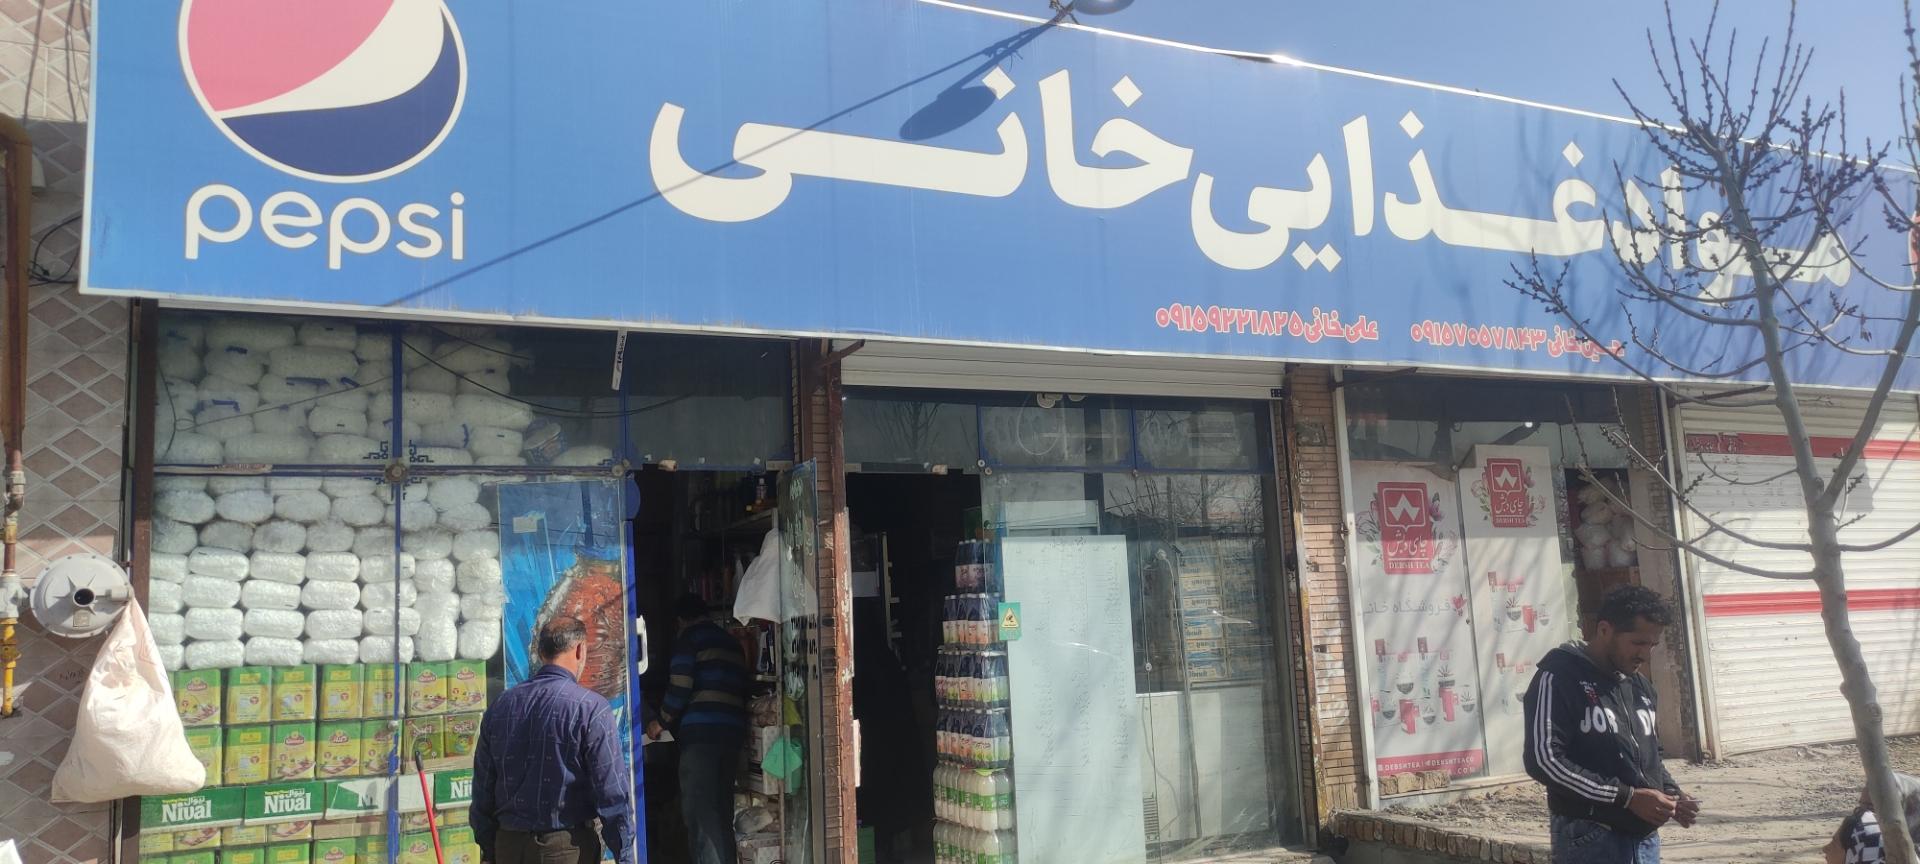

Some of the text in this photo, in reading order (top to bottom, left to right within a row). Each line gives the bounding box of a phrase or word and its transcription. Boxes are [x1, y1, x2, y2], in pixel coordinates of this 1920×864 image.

[650, 66, 1851, 306] مواد غذایی خانی
[185, 184, 465, 270] pepsi
[1304, 307, 1345, 343] خانی
[1345, 315, 1379, 343] علی
[1363, 600, 1388, 615] خان
[161, 800, 212, 822] Nival
[264, 792, 311, 814] Nival
